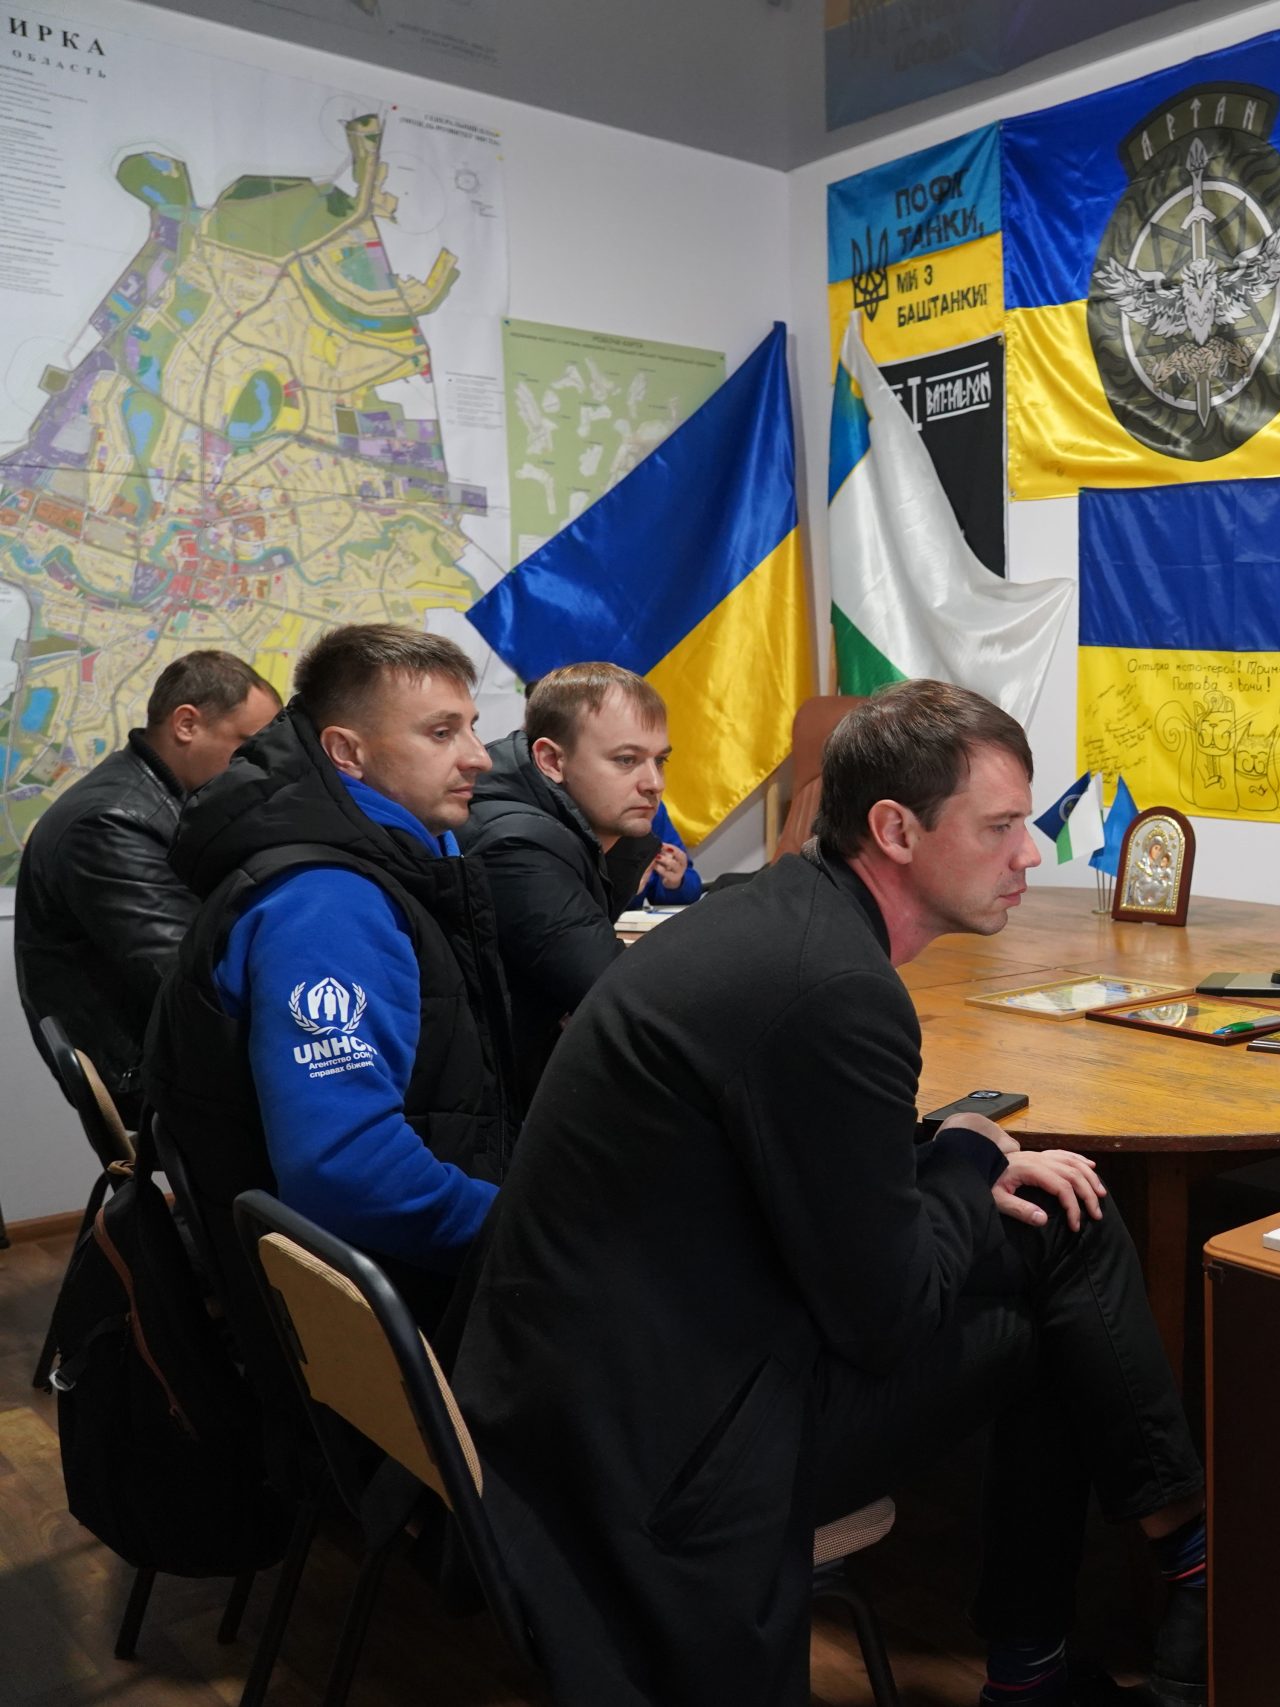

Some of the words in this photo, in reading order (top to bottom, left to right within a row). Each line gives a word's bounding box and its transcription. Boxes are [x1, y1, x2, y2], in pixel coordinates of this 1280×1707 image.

[12, 49, 107, 79] ОБЛАСТЬ
[896, 269, 919, 294] МИ
[924, 264, 933, 286] З
[897, 283, 989, 328] БАШТАНКИ!
[309, 1055, 352, 1071] Агентство
[309, 1066, 346, 1079] справах
